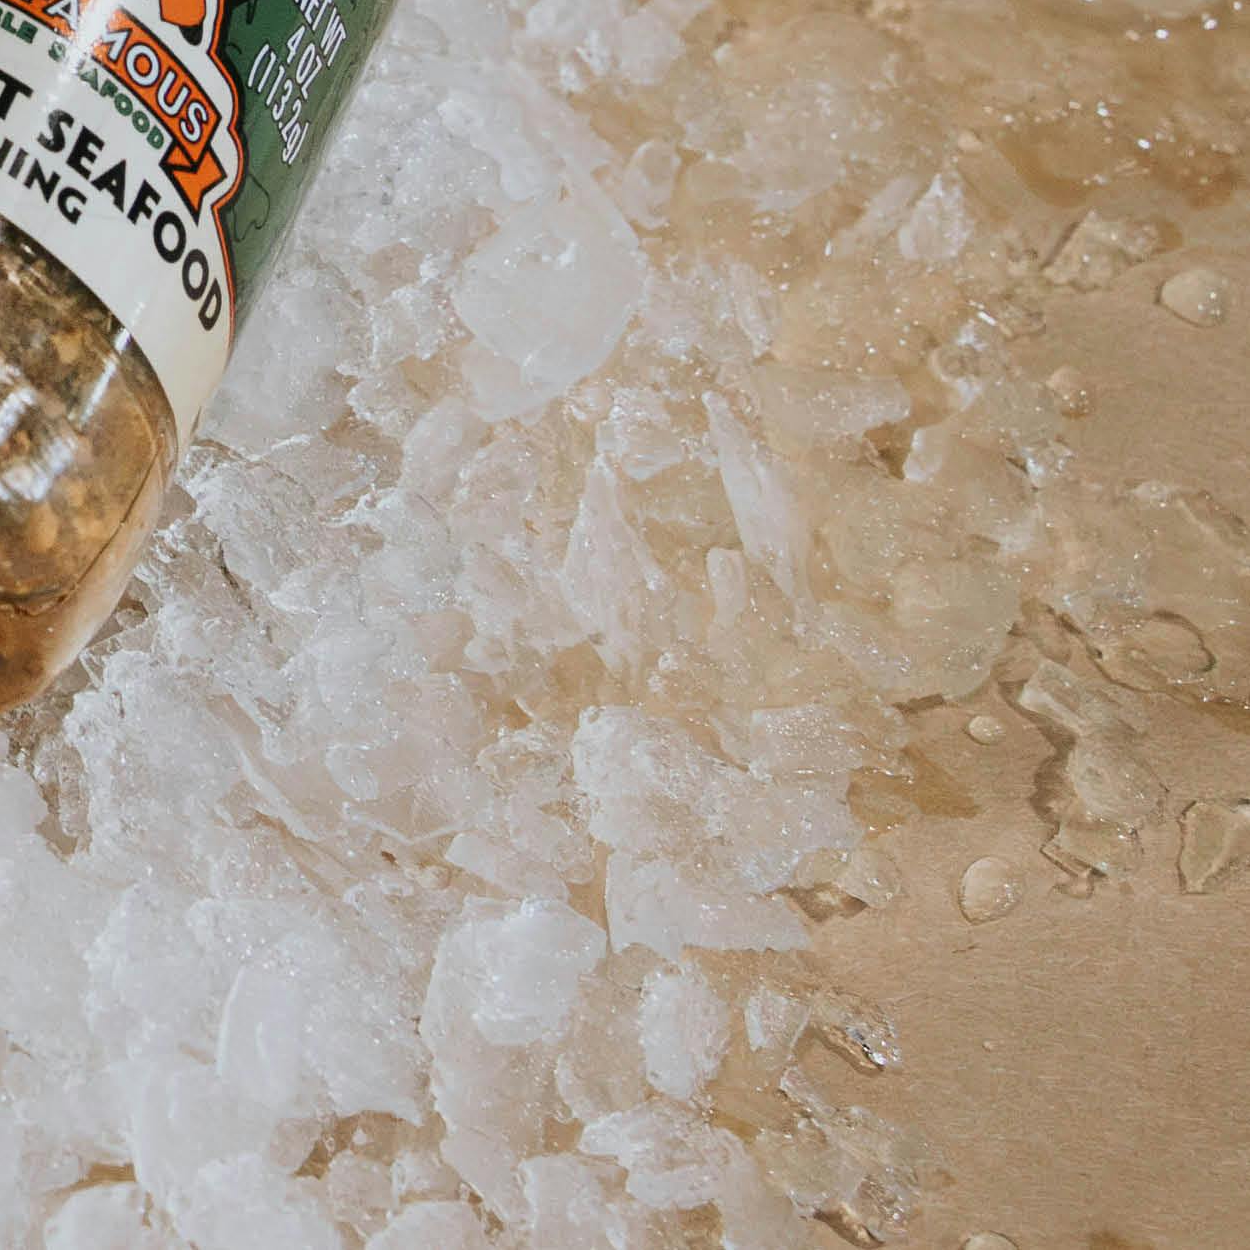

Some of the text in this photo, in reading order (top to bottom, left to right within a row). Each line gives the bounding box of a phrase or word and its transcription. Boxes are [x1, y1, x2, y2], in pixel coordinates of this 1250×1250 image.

[286, 25, 323, 100] 4 OZ
[320, 7, 347, 68] WT
[47, 39, 166, 151] SAFOOD
[247, 43, 310, 166] (113.2g)
[36, 108, 223, 332] SEAFOOD
